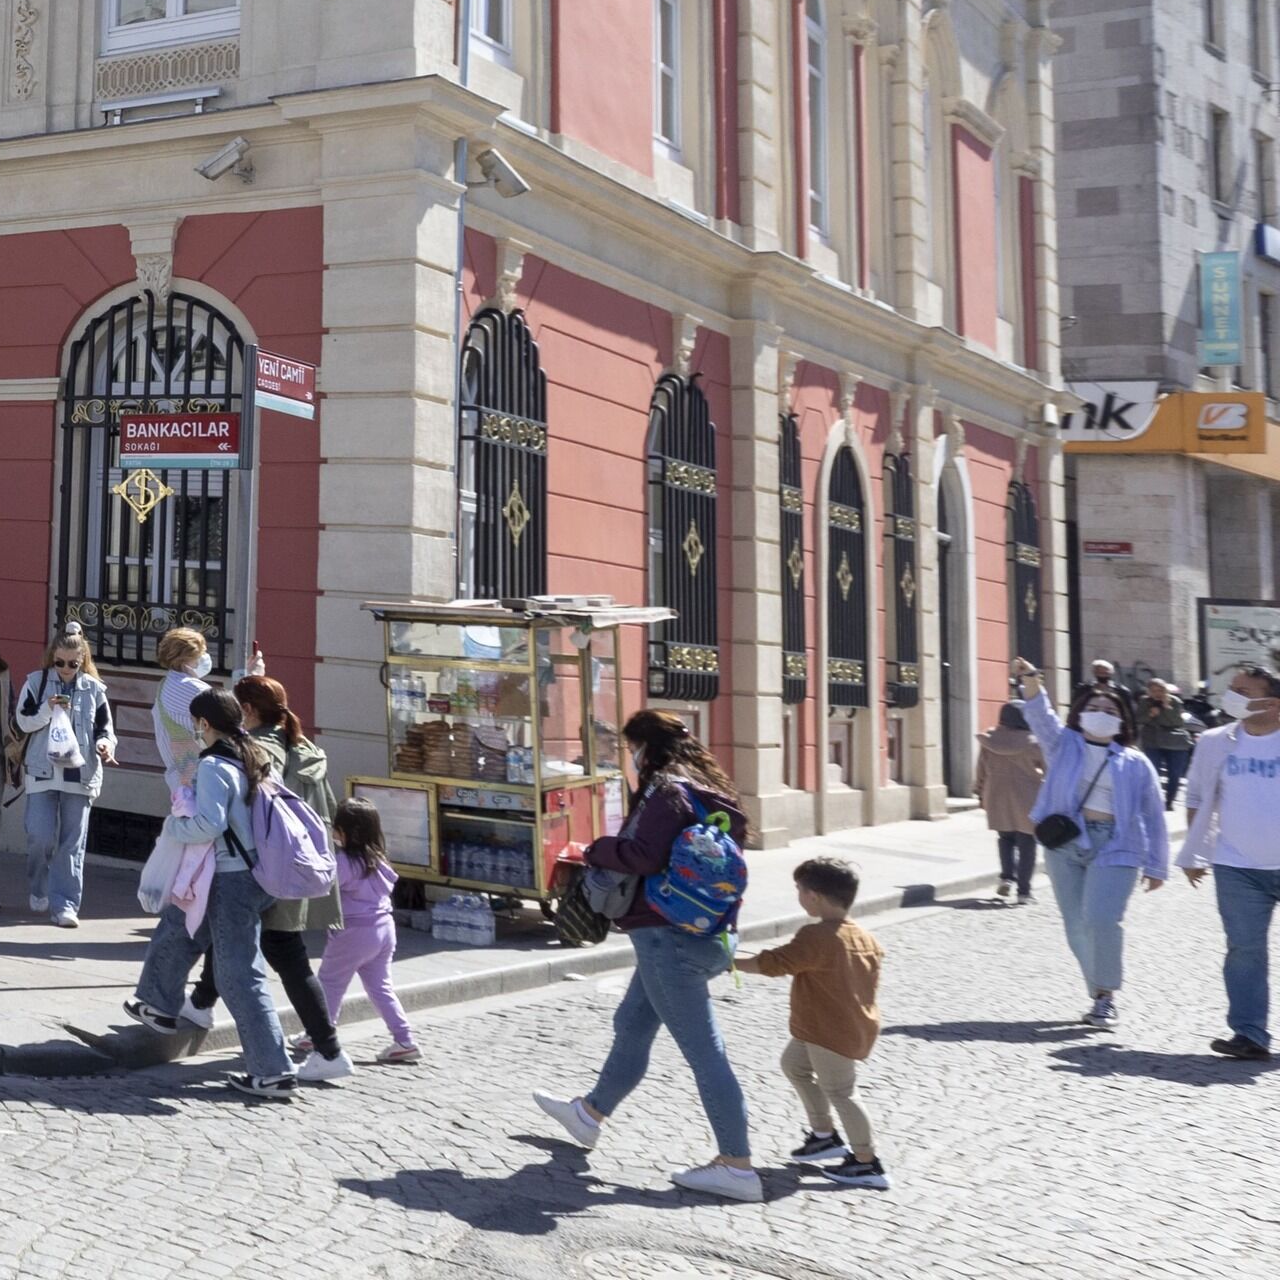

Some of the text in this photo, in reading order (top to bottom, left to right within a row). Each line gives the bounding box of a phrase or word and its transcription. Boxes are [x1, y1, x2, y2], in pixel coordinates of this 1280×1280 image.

[258, 357, 280, 378] YENİ
[126, 422, 230, 438] BANKACILAR
[124, 442, 160, 451] SOKAĞI
